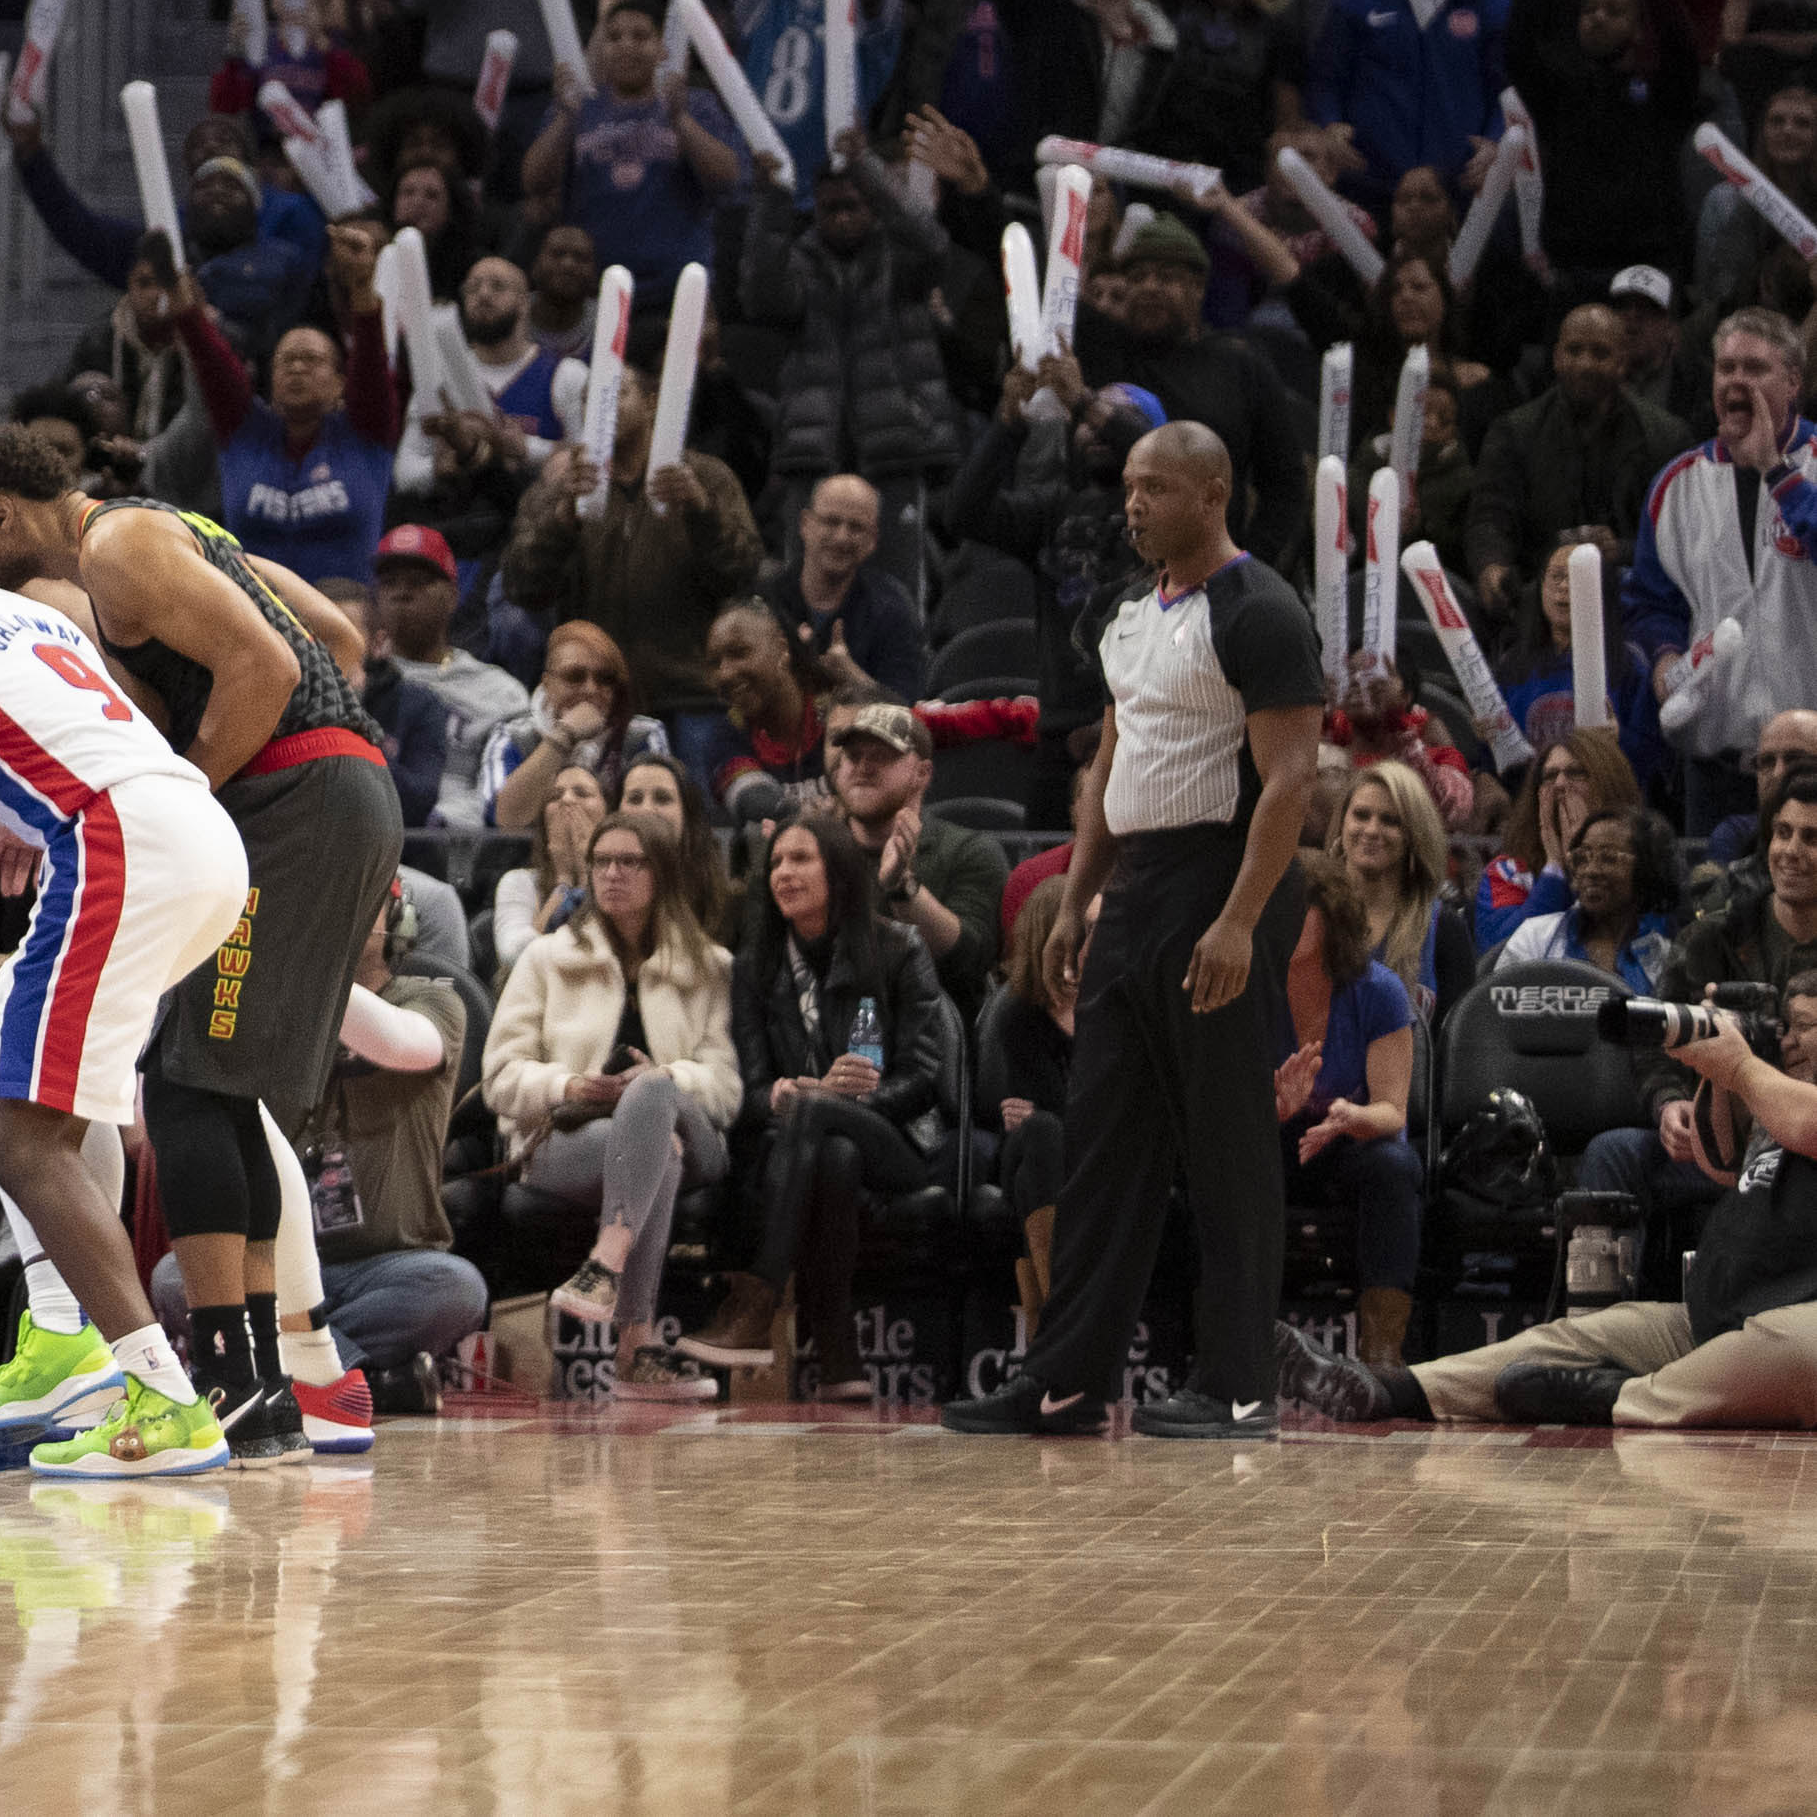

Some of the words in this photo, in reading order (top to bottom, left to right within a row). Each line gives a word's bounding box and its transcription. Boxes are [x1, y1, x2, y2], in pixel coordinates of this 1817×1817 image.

[246, 480, 349, 522] PISTONS
[31, 642, 134, 723] 9
[1489, 985, 1611, 1001] MEADE
[1496, 999, 1603, 1016] LEXUS
